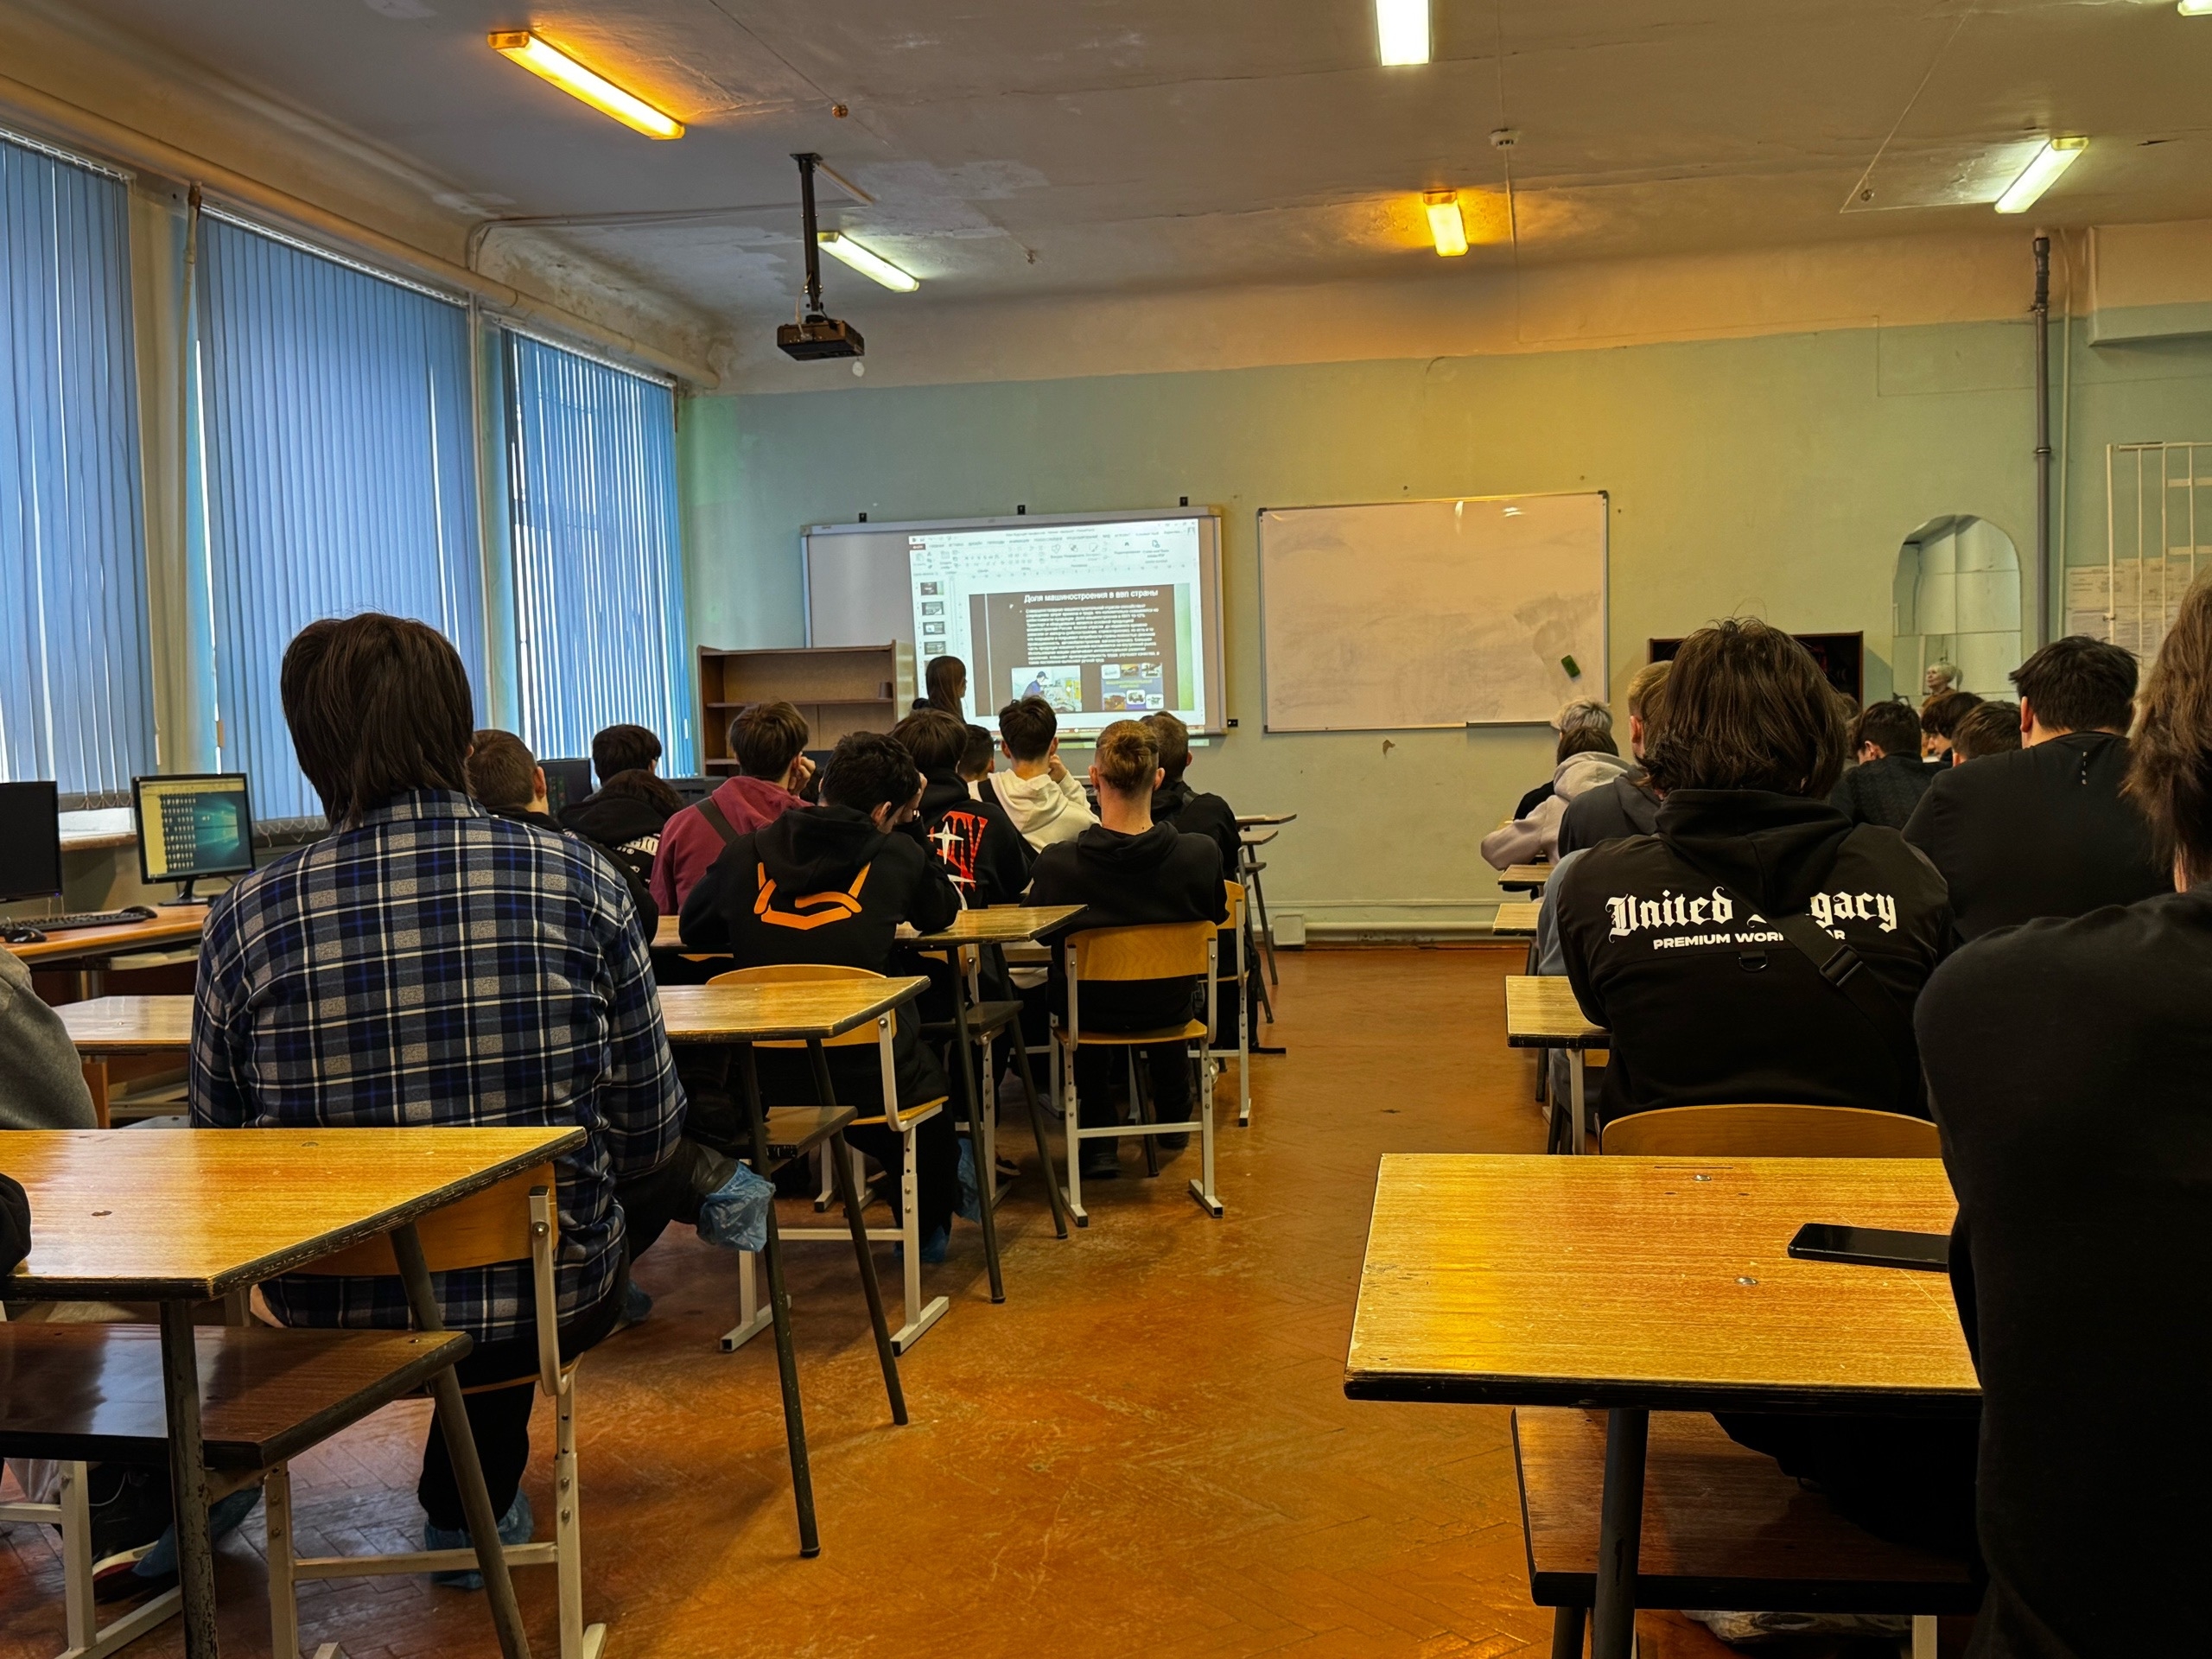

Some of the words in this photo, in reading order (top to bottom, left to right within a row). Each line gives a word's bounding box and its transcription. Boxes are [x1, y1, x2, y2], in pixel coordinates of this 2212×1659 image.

[1024, 594, 1043, 603] Доля
[1045, 591, 1108, 601] машиностроения
[1130, 589, 1158, 598] страны
[1605, 886, 1733, 943] United
[1746, 891, 1897, 933] gacy
[1653, 933, 1731, 950] PREMIUM
